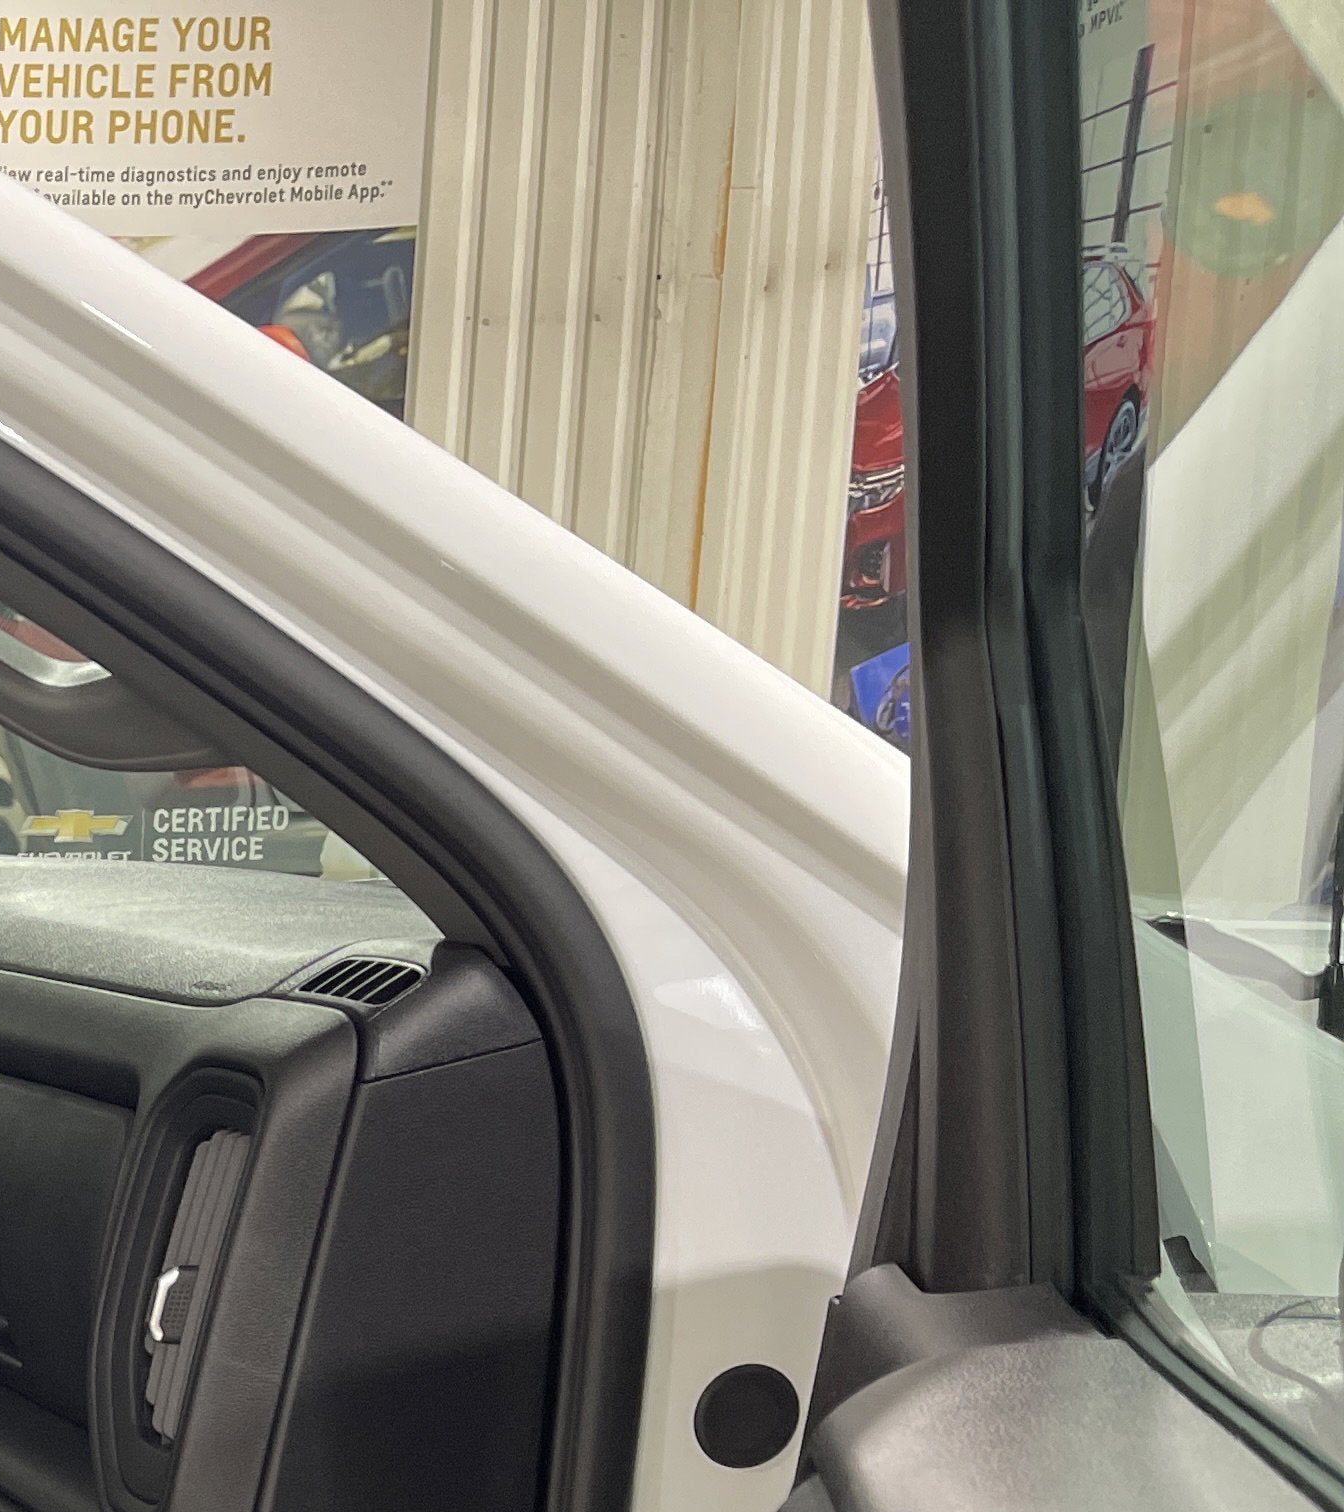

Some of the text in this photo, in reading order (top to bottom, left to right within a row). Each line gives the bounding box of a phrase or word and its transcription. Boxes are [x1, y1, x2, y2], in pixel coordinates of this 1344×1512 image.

[172, 16, 272, 51] YOUR
[169, 62, 273, 98] FROM
[108, 108, 246, 144] PHONE.
[36, 165, 115, 183] real-time
[120, 165, 217, 186] diagnostics
[222, 164, 252, 181] and
[257, 163, 303, 185] enjoy
[307, 162, 367, 179] remote
[121, 193, 141, 206] on
[146, 190, 173, 206] the
[178, 187, 285, 209] myChevrolet
[290, 186, 344, 203] Mobile
[152, 804, 290, 834] CERTIFIED
[151, 836, 265, 862] SERVICE
